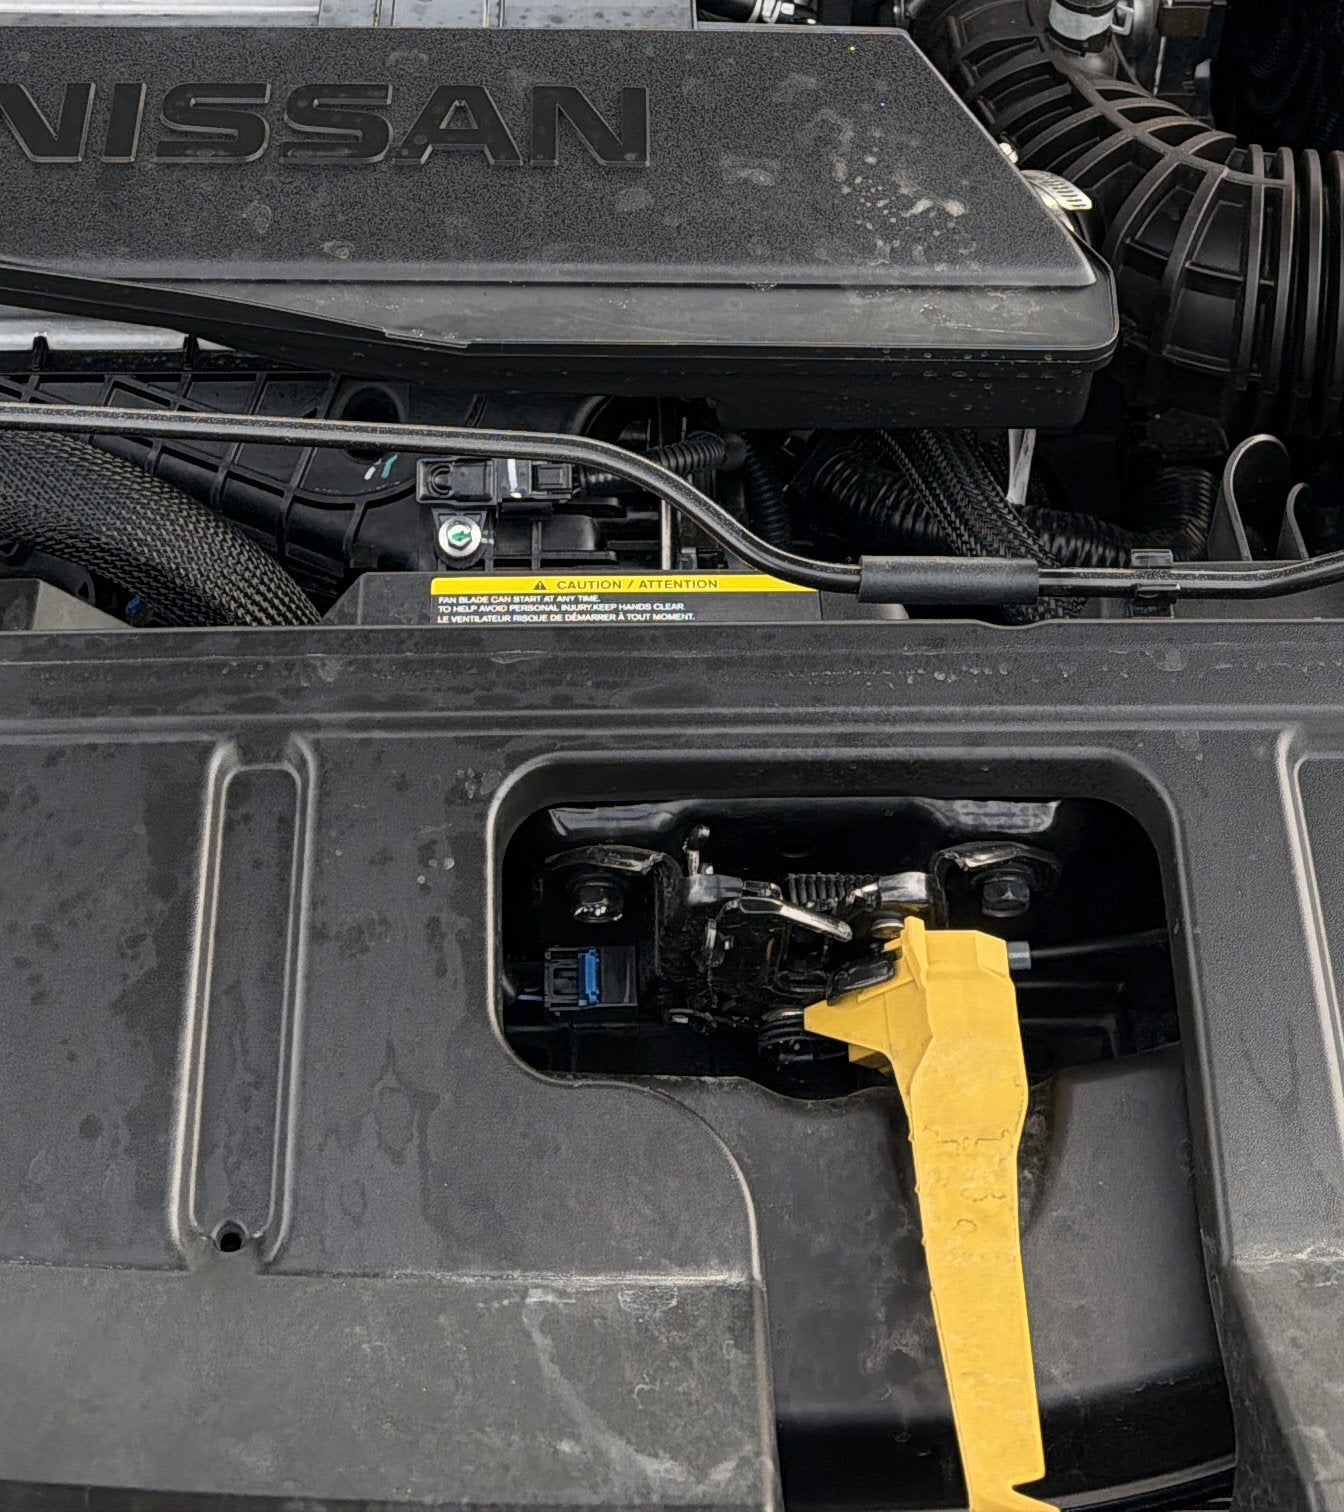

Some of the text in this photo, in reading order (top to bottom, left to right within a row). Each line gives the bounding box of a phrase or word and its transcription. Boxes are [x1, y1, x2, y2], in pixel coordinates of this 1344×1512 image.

[557, 579, 718, 590] CAUTION / ATTENTION
[438, 596, 457, 604] FAN
[459, 596, 489, 604] BLADE
[490, 595, 511, 603] CAN
[513, 595, 541, 603] START
[543, 595, 555, 603] AT
[556, 595, 576, 603] ANY
[438, 605, 452, 613] TO
[453, 605, 478, 613] HELP
[479, 605, 507, 613] AVOID
[509, 604, 559, 612] PERSONAL
[619, 603, 651, 611] HANDS
[437, 615, 449, 623] LE
[450, 615, 511, 623] VENTILATEUR
[512, 614, 548, 623] RISQUE
[550, 614, 563, 622] DE
[564, 612, 616, 622] DÉMARRER
[626, 613, 651, 621] TOUT
[652, 613, 696, 621] MOMENT.
